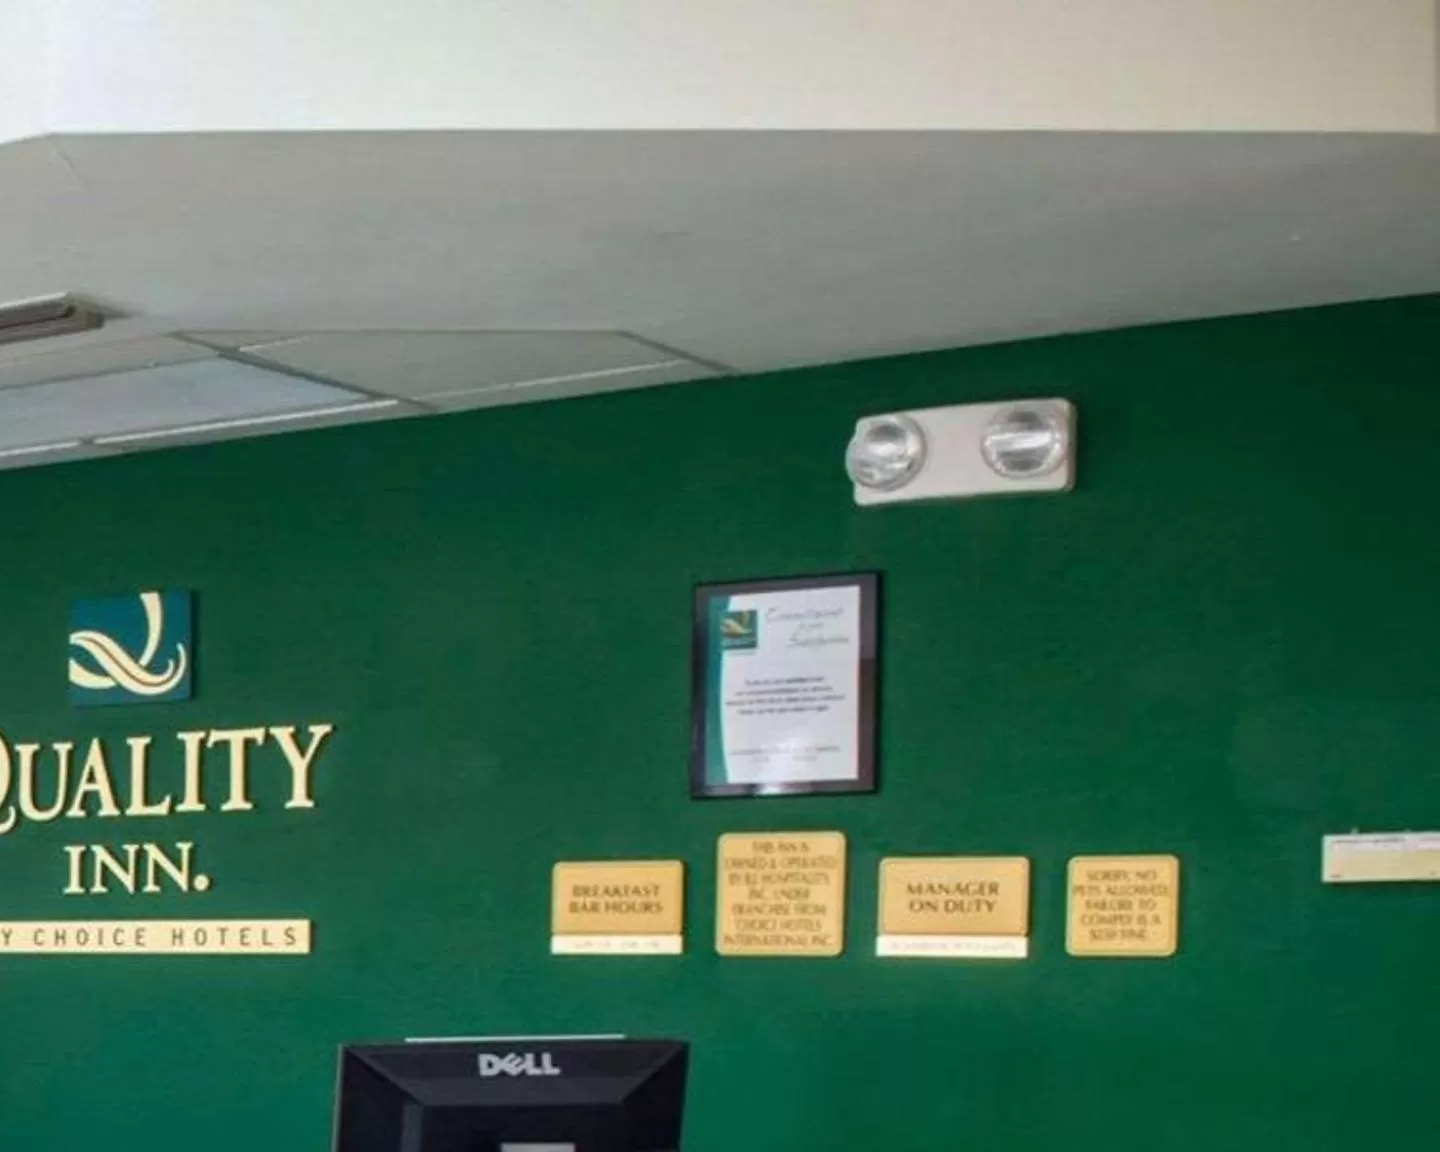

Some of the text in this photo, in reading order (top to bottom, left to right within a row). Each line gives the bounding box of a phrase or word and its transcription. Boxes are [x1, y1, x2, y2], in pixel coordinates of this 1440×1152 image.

[572, 883, 661, 898] BREAKFAST
[907, 881, 1000, 896] MANAGER
[569, 901, 664, 915] BAR HOURS
[909, 898, 997, 914] ON DUTY
[33, 926, 148, 946] CHOICE
[171, 926, 297, 946] HOTELS
[477, 1052, 561, 1077] DELL
